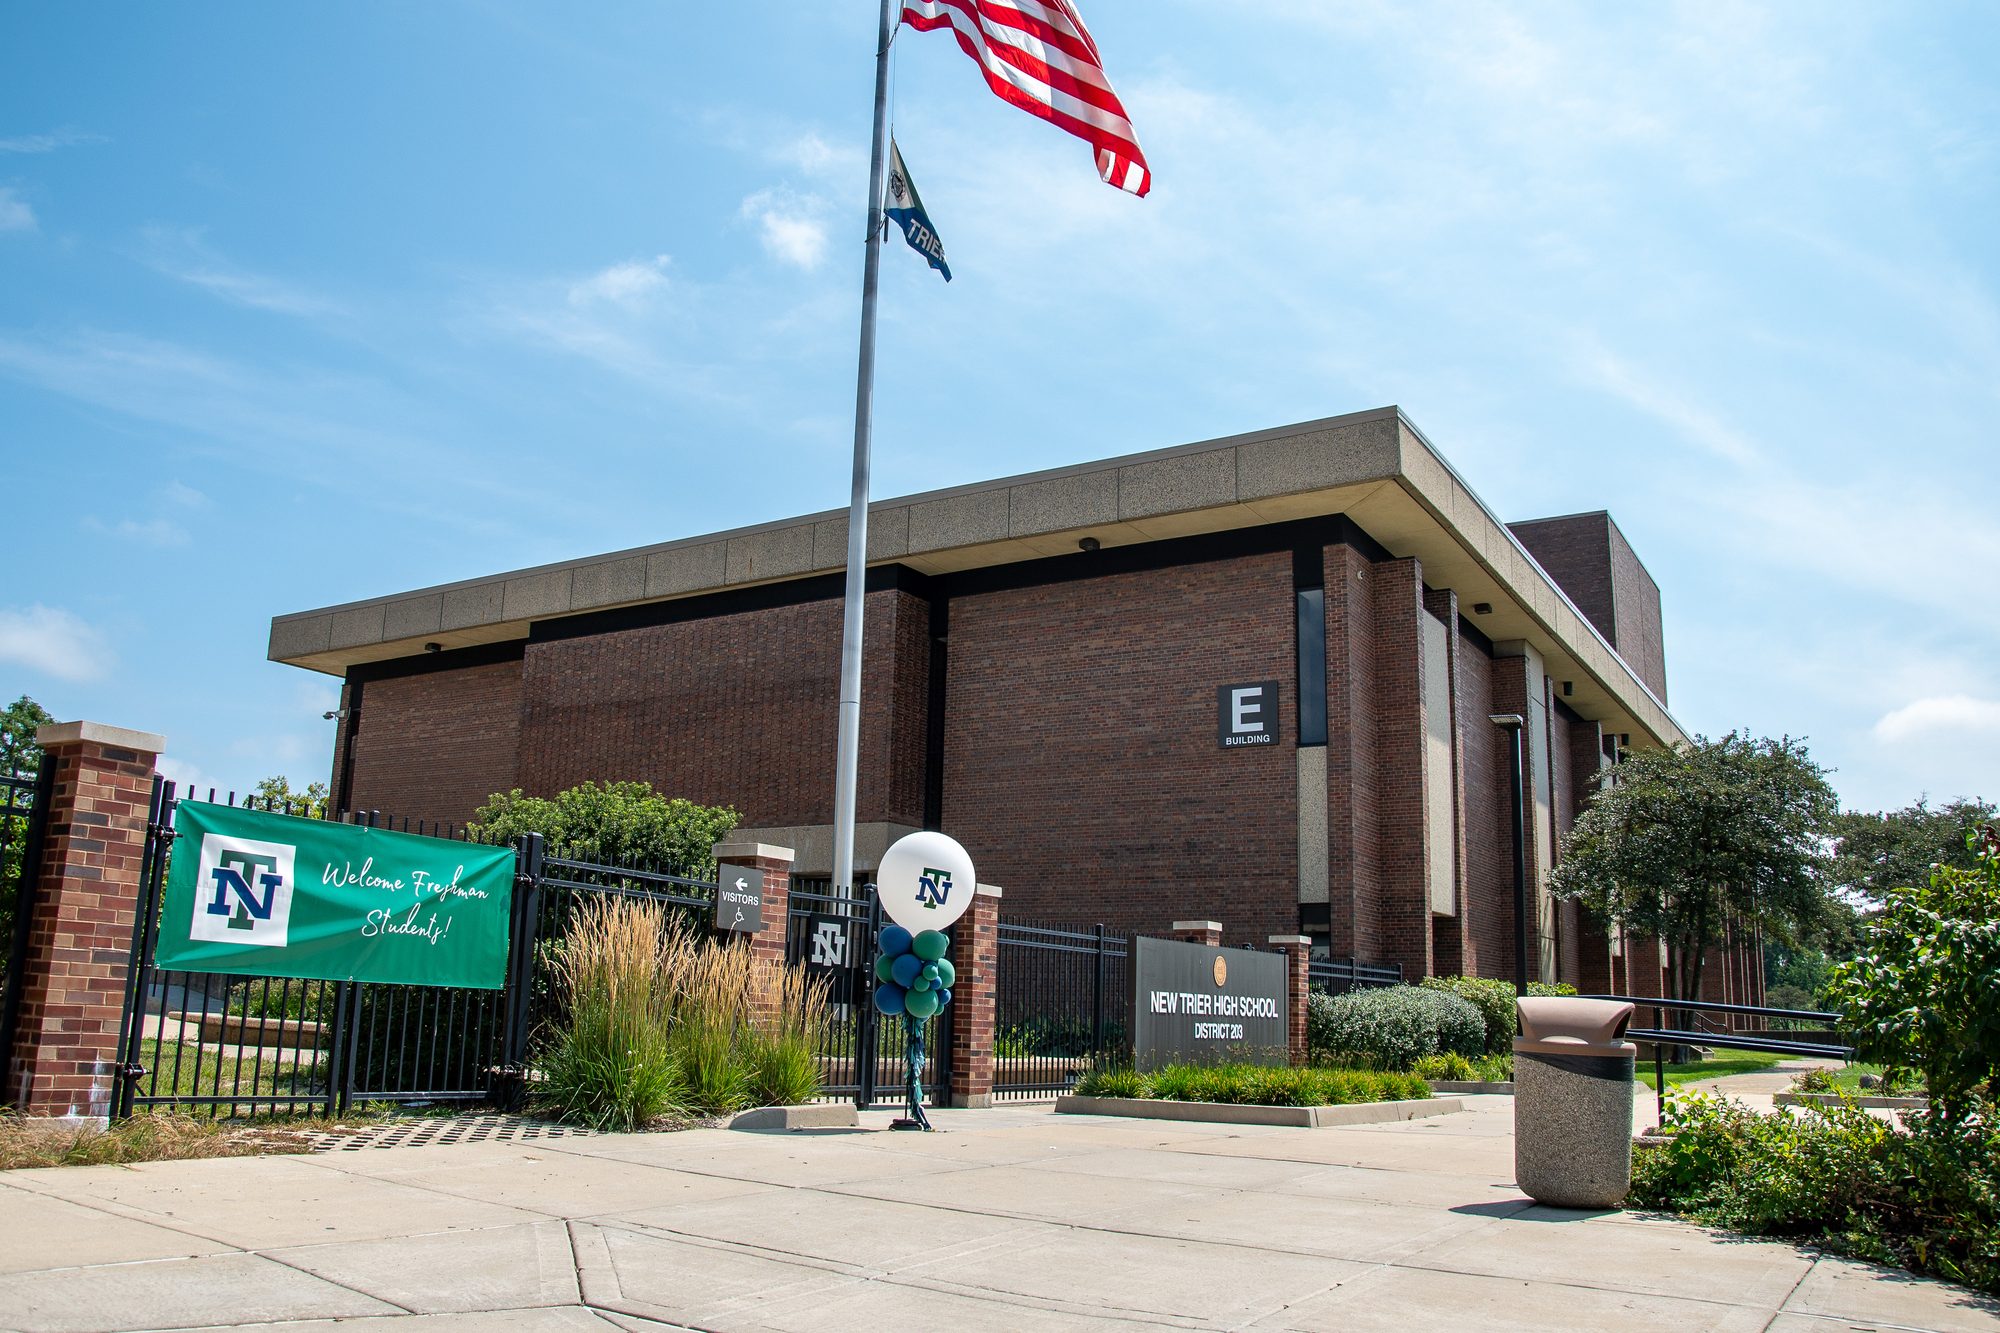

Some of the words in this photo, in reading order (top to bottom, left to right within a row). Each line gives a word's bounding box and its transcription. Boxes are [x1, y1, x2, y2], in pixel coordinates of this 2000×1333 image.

[1232, 687, 1263, 733] E
[1226, 734, 1270, 745] BUILDING
[322, 856, 405, 892] Welcome
[412, 865, 489, 902] Freshman
[722, 891, 759, 906] VISITORS
[361, 903, 453, 945] Students!
[1150, 991, 1178, 1014] NEW
[1180, 993, 1211, 1015] TRIER
[1214, 995, 1237, 1016] HIGH
[1239, 997, 1279, 1018] SCHOOL
[1195, 1023, 1230, 1039] DISTRICT
[1230, 1024, 1243, 1039] 203
